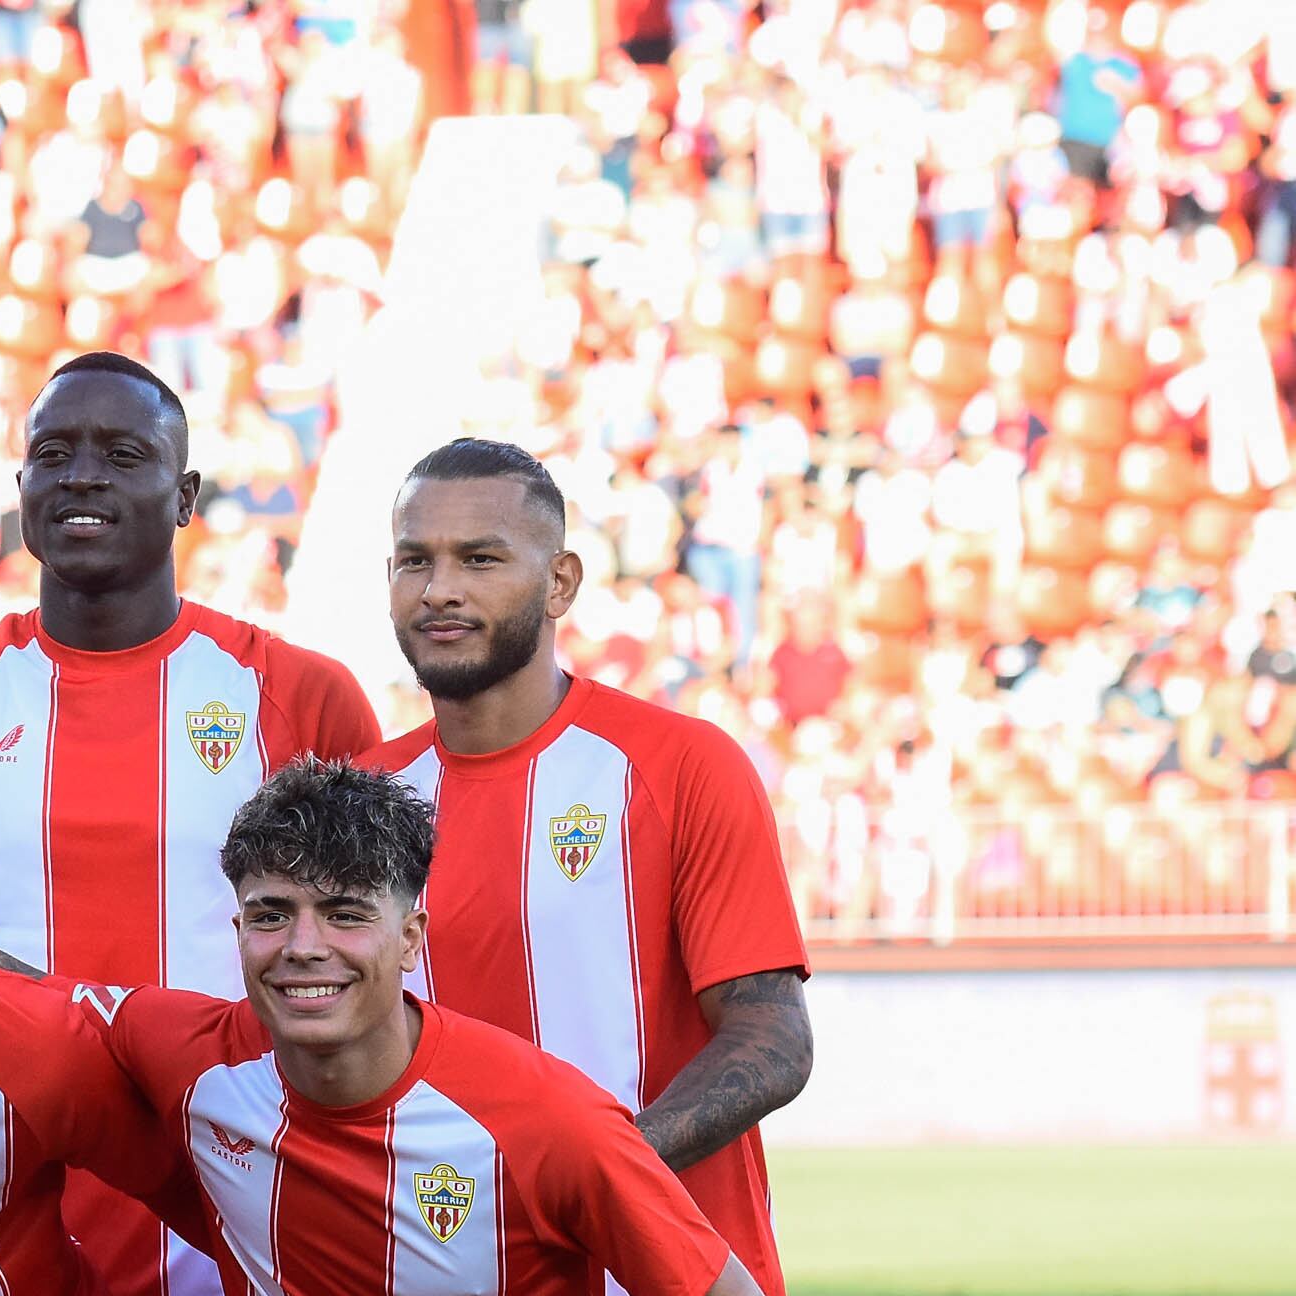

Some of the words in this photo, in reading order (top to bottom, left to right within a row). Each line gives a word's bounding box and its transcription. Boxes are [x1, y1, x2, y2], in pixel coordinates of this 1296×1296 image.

[193, 730, 238, 739] ALMERIA
[556, 834, 597, 844] ALMERIA
[212, 1146, 251, 1171] CASTORE
[422, 1195, 466, 1206] ALMERIA
